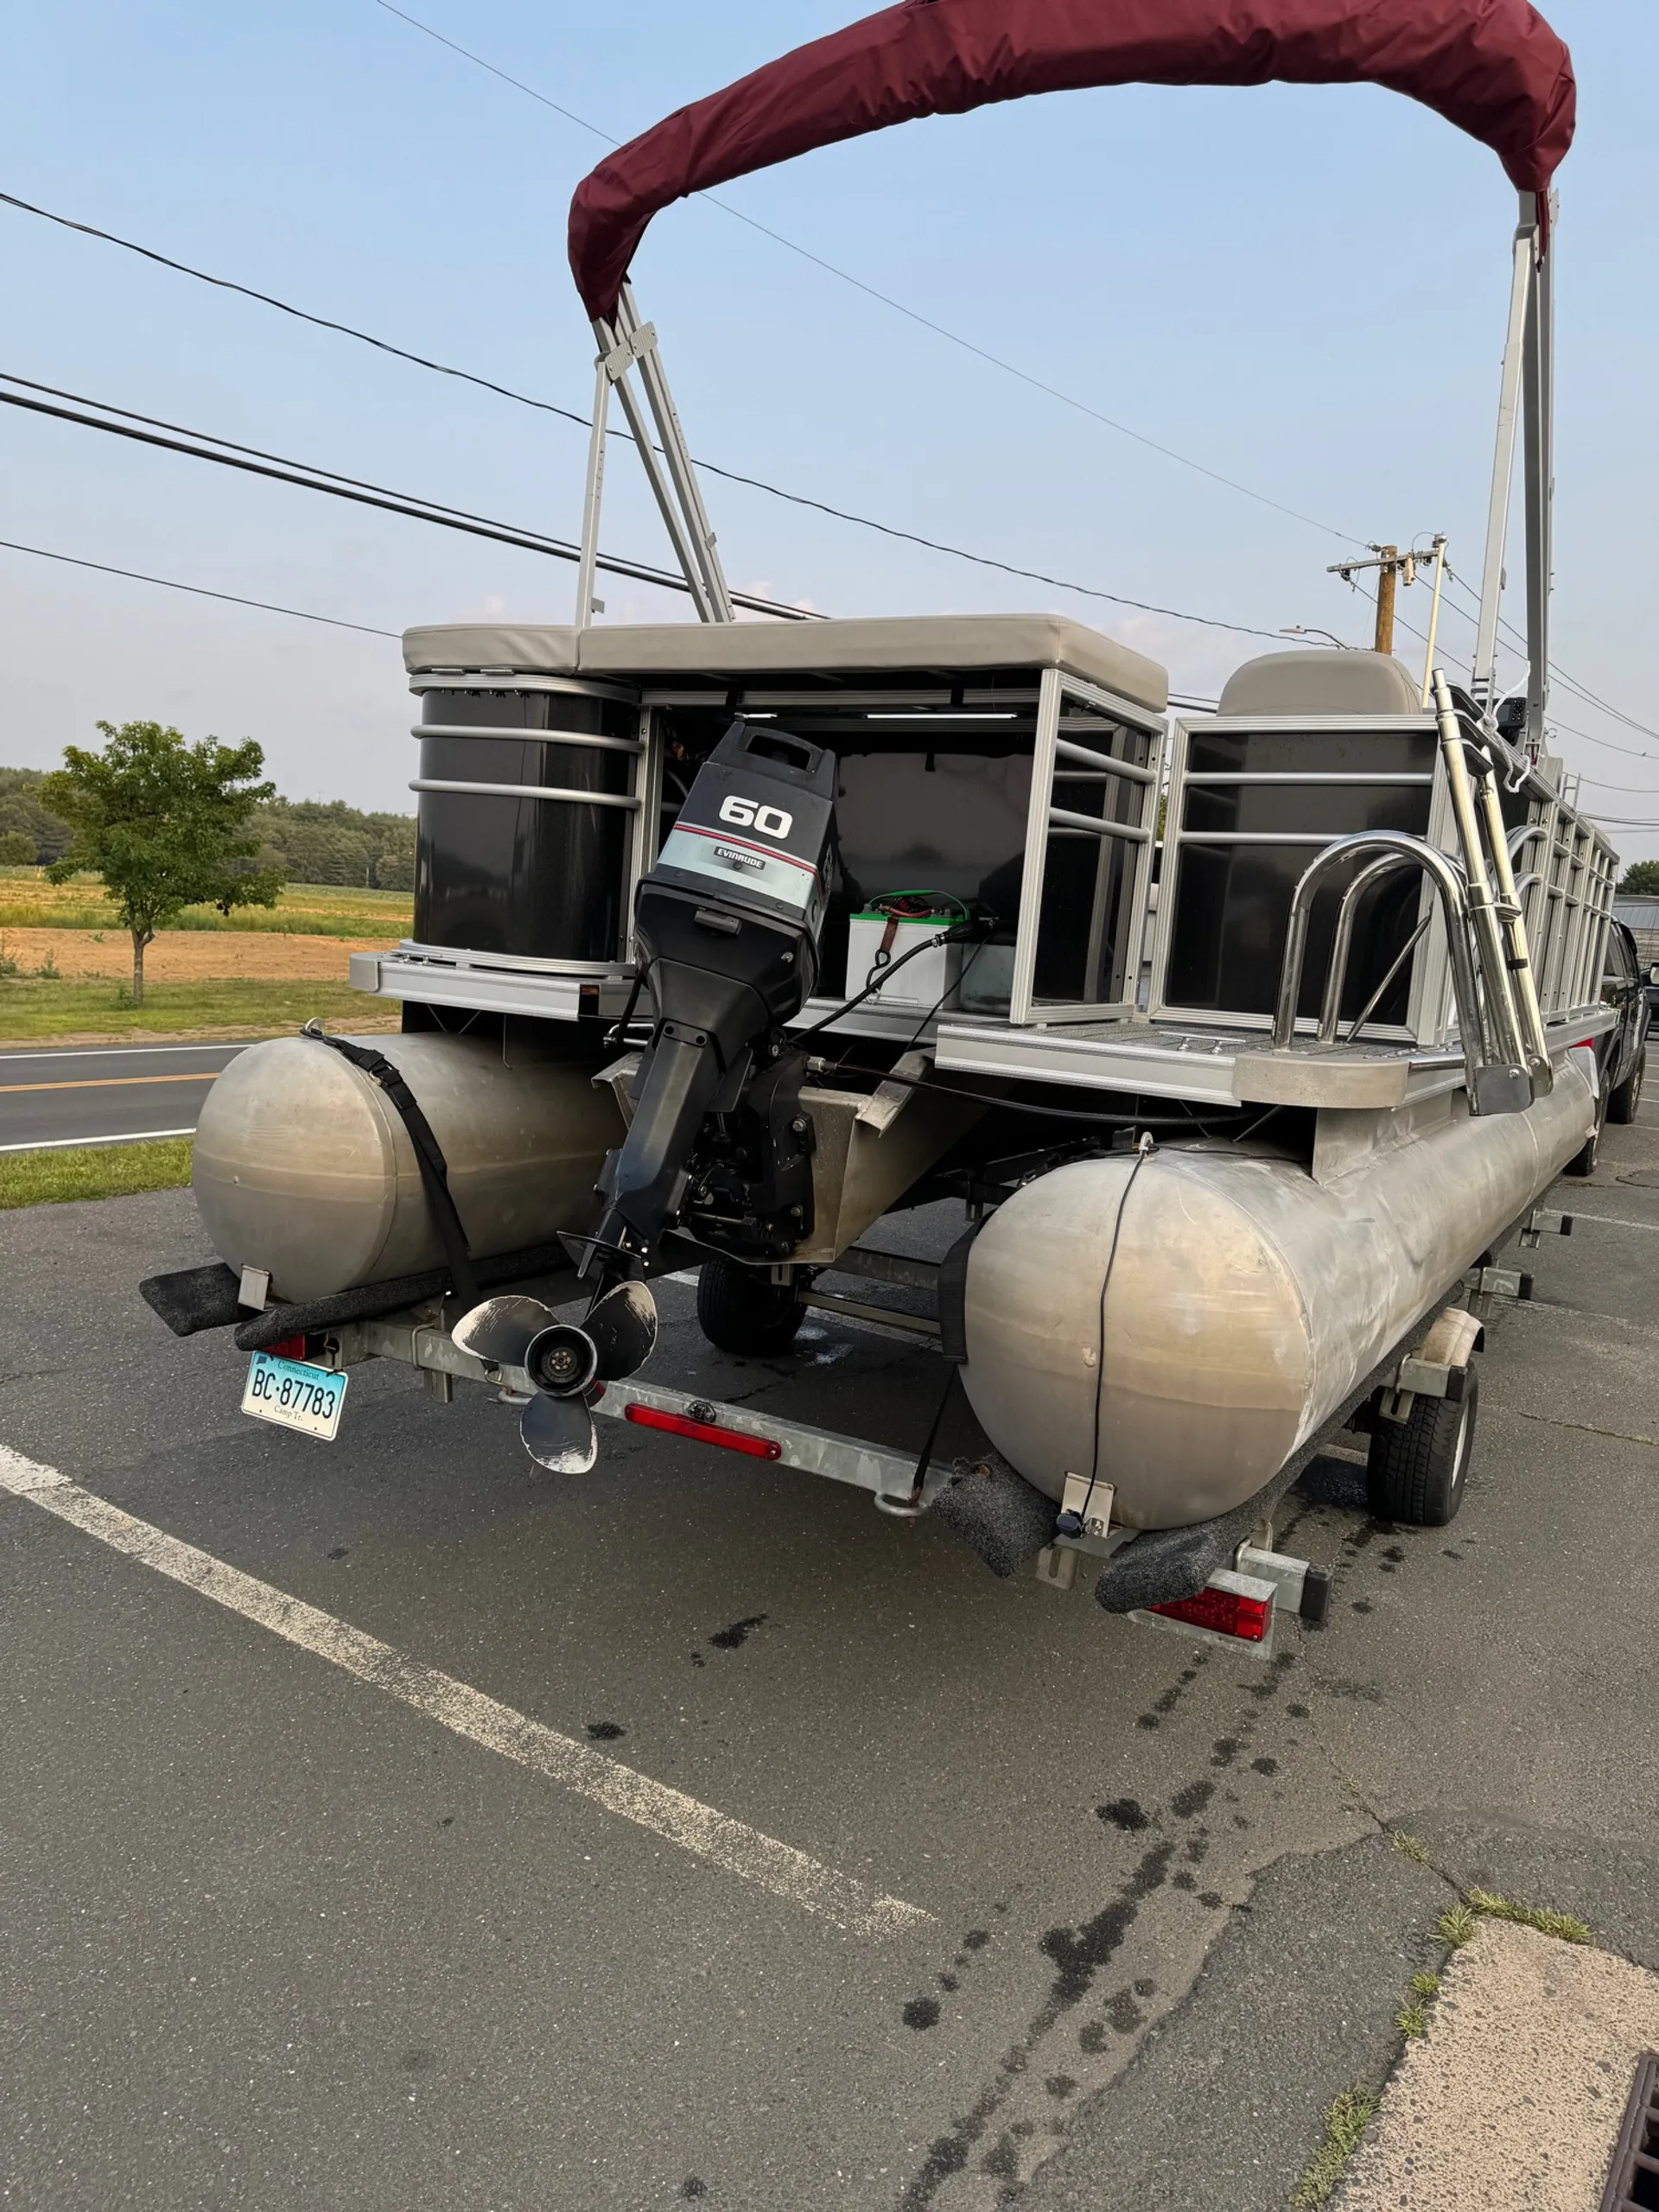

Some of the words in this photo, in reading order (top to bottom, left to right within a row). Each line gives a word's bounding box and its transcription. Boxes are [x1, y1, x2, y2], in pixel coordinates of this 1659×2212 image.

[719, 795, 793, 840] 60
[717, 848, 763, 868] EVINRUDE
[277, 1360, 320, 1380] Connecticut
[274, 1404, 292, 1419] Camp
